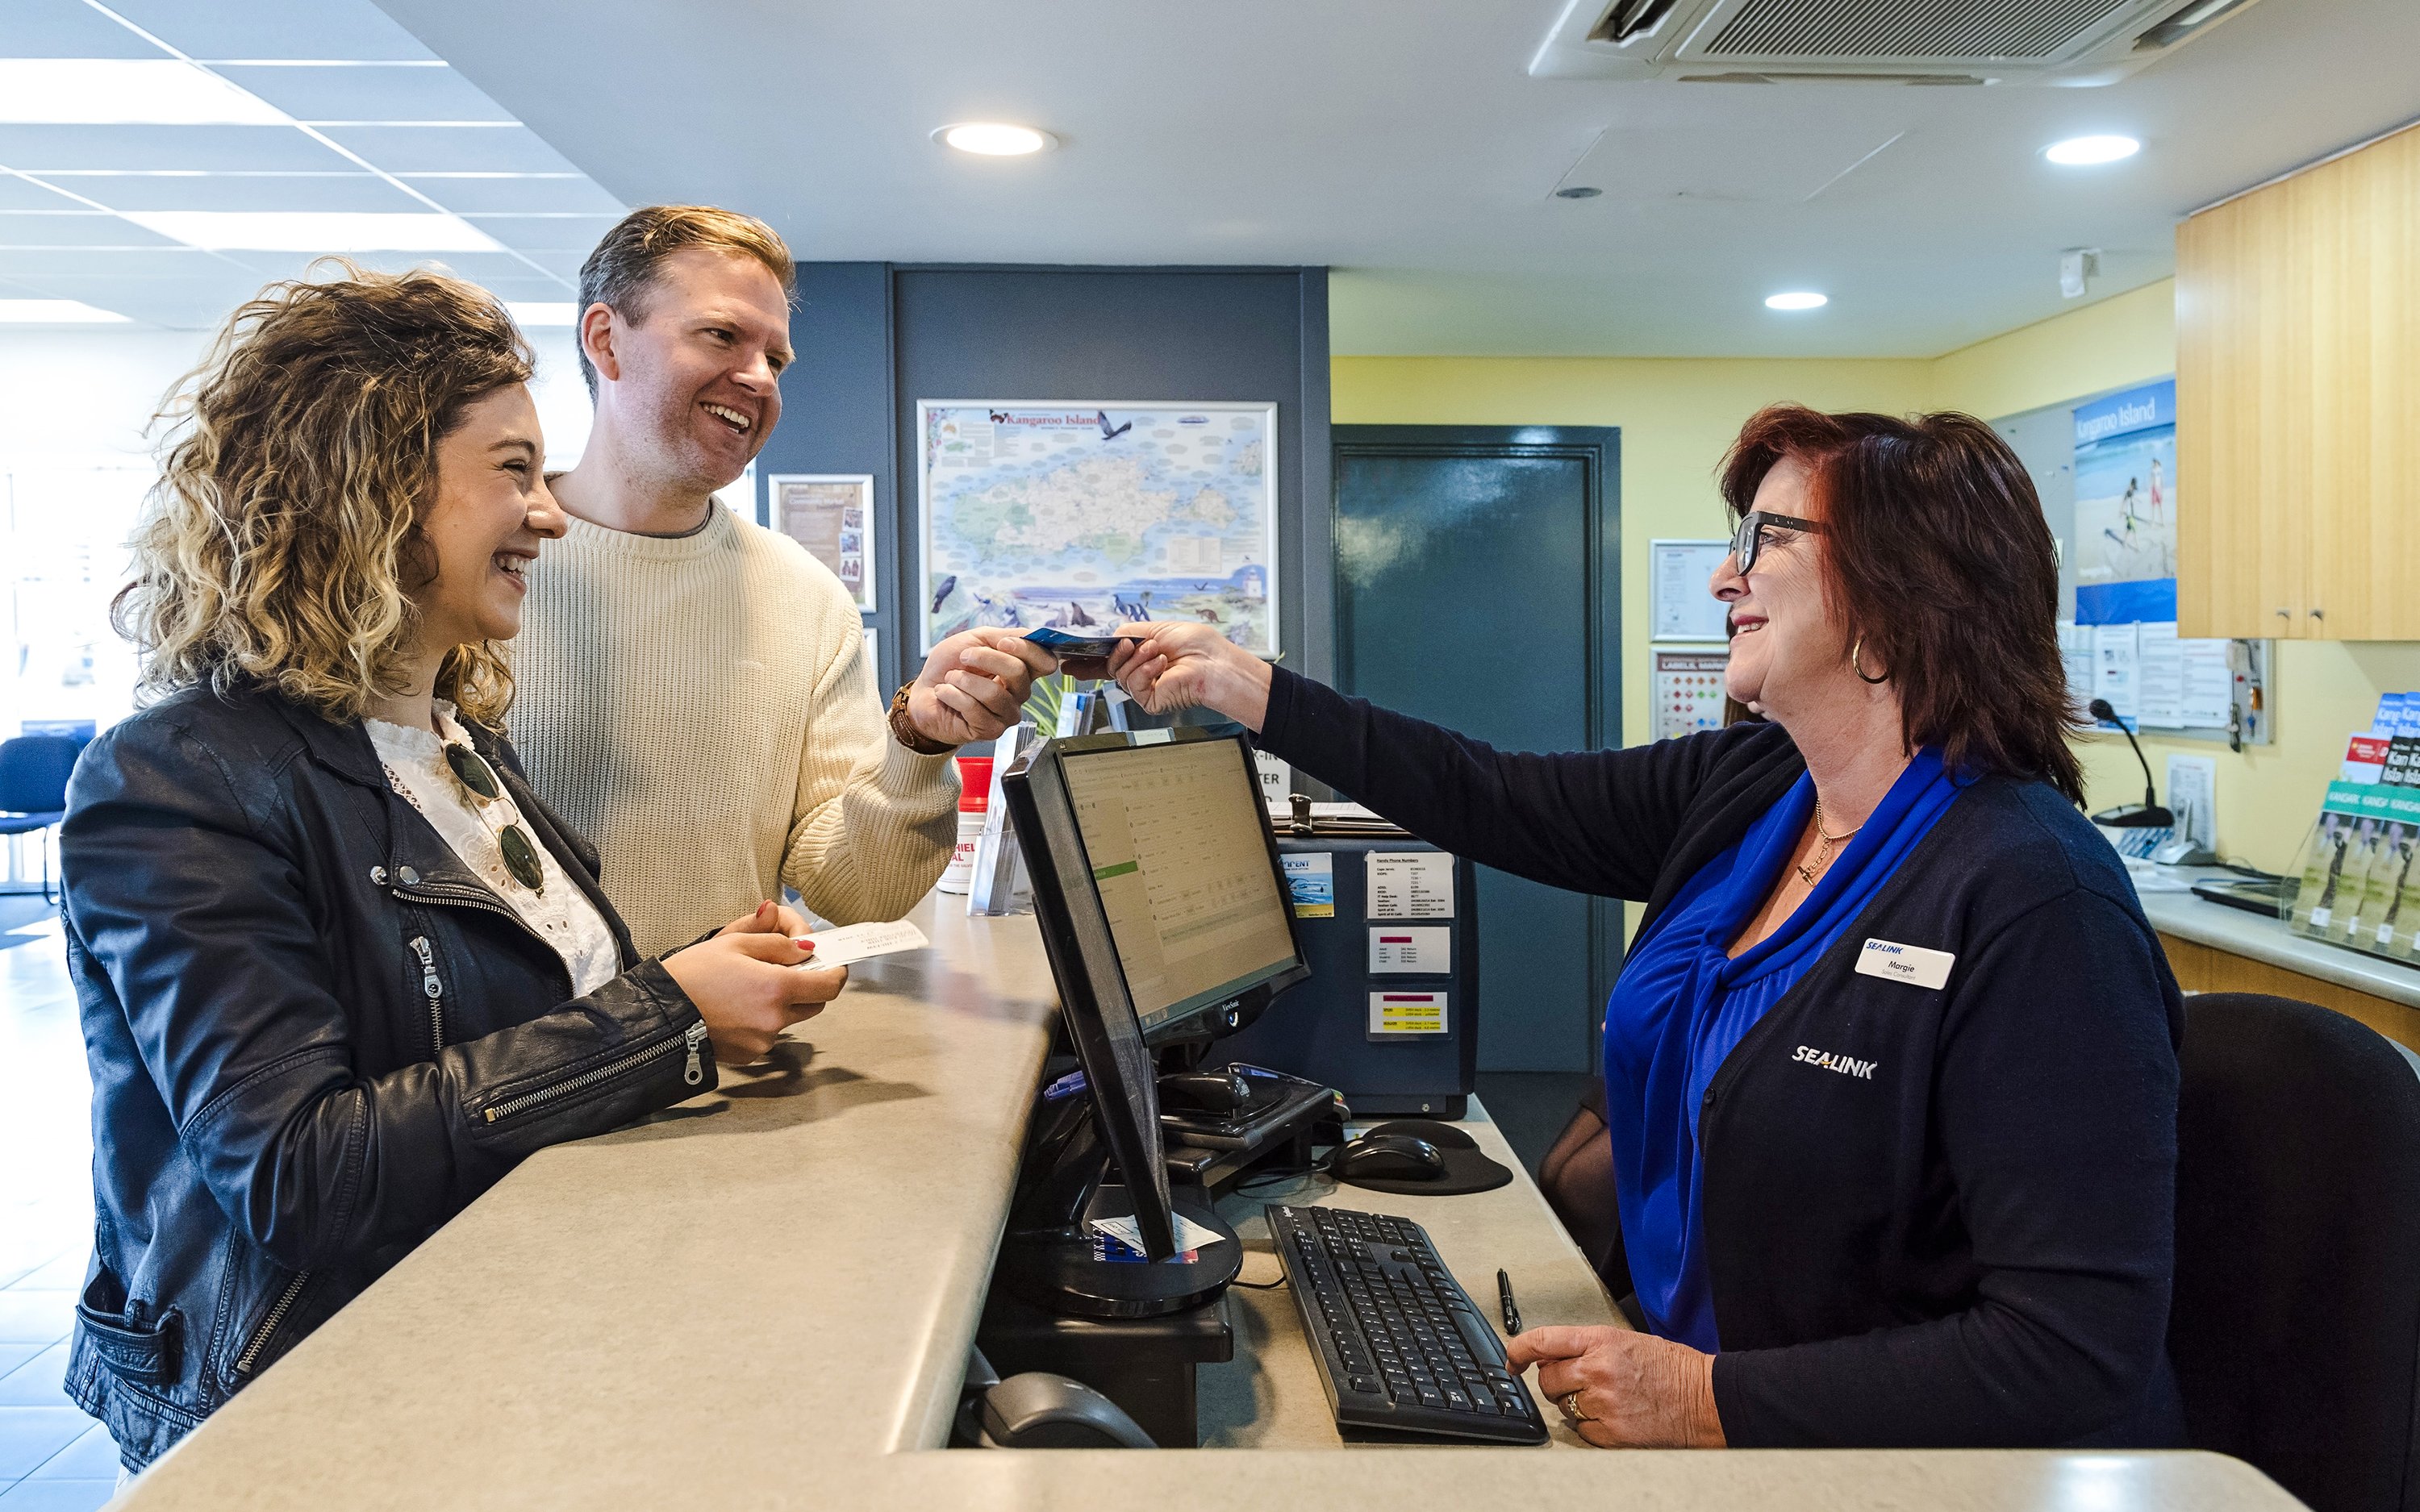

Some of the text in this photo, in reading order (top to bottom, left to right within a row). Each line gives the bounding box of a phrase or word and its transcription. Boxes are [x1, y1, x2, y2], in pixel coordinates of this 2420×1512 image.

[2118, 396, 2155, 427] Island
[1008, 414, 1100, 428] Kangaroo Island
[1866, 942, 1903, 955] SEALINK
[1888, 960, 1915, 973] Margie
[1893, 971, 1916, 981] Consultant
[1792, 1045, 1878, 1081] SEALINK
